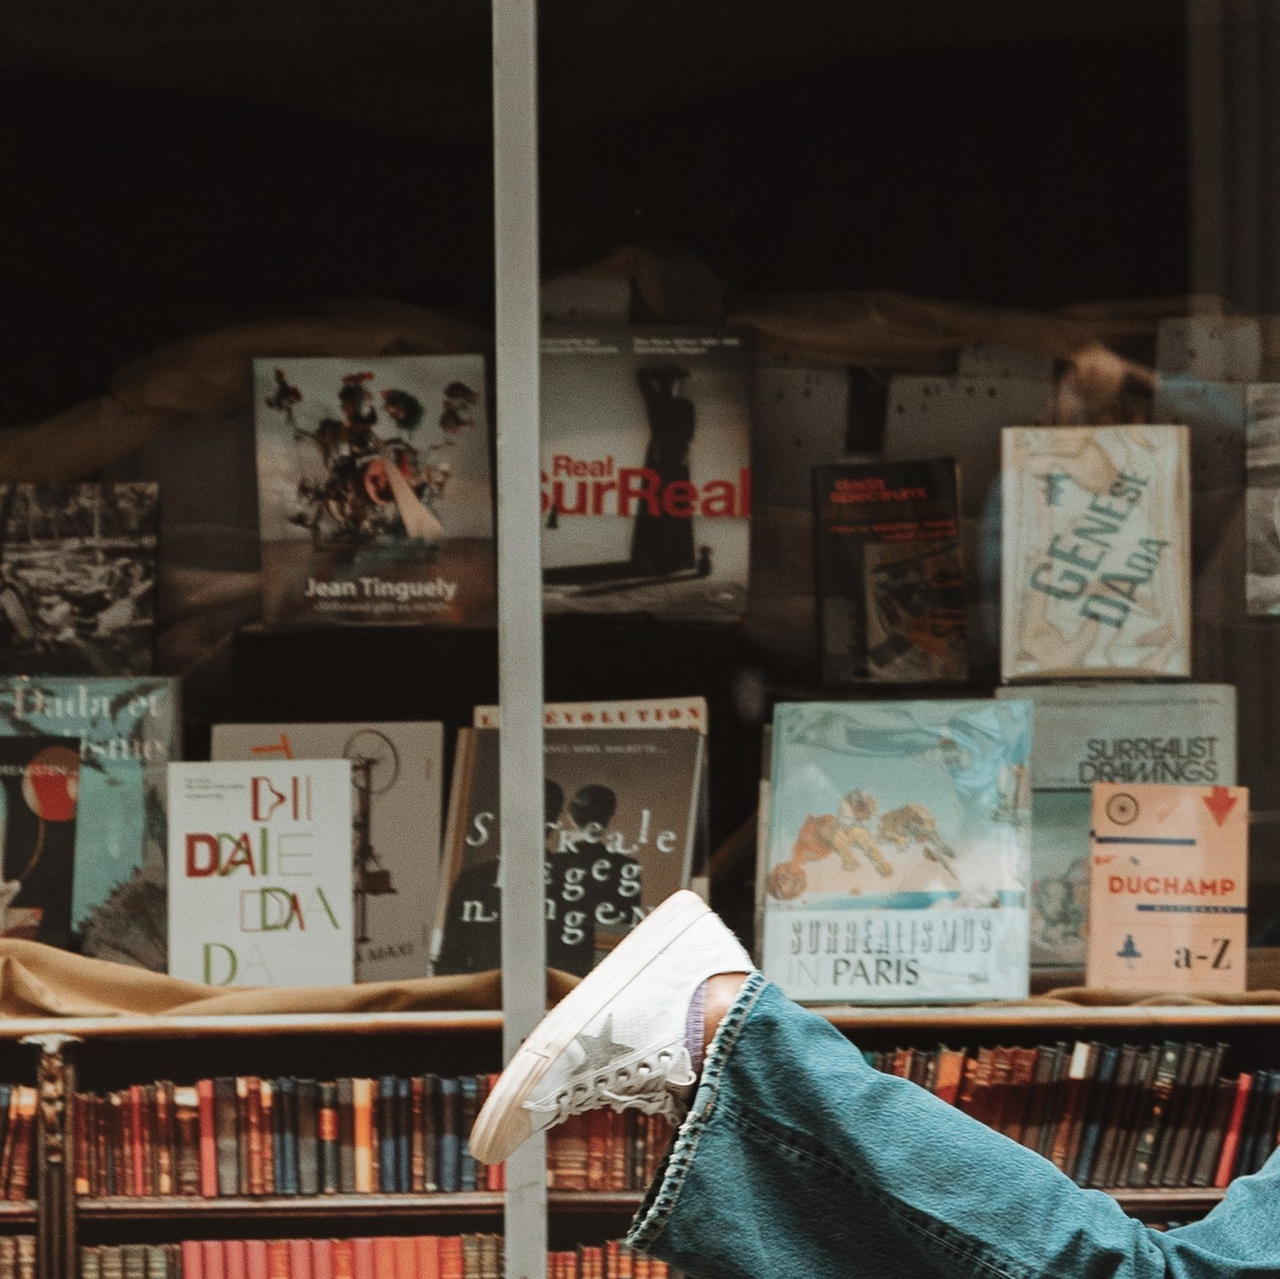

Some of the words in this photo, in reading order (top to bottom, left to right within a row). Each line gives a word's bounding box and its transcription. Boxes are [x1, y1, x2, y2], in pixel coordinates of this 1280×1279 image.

[552, 453, 614, 478] Real
[540, 466, 752, 518] urReal
[304, 577, 358, 598] Jean
[359, 576, 459, 603] Tinguely
[1079, 536, 1170, 630] DADA
[543, 706, 702, 726] EVOLUTION
[1086, 735, 1219, 762] SURREALIST
[1078, 760, 1219, 784] DRAWINGS
[1107, 874, 1237, 897] DUCHAMP
[790, 918, 993, 956] SURREALISMUS
[1173, 937, 1233, 970] a-Z
[832, 958, 920, 987] PARIS
